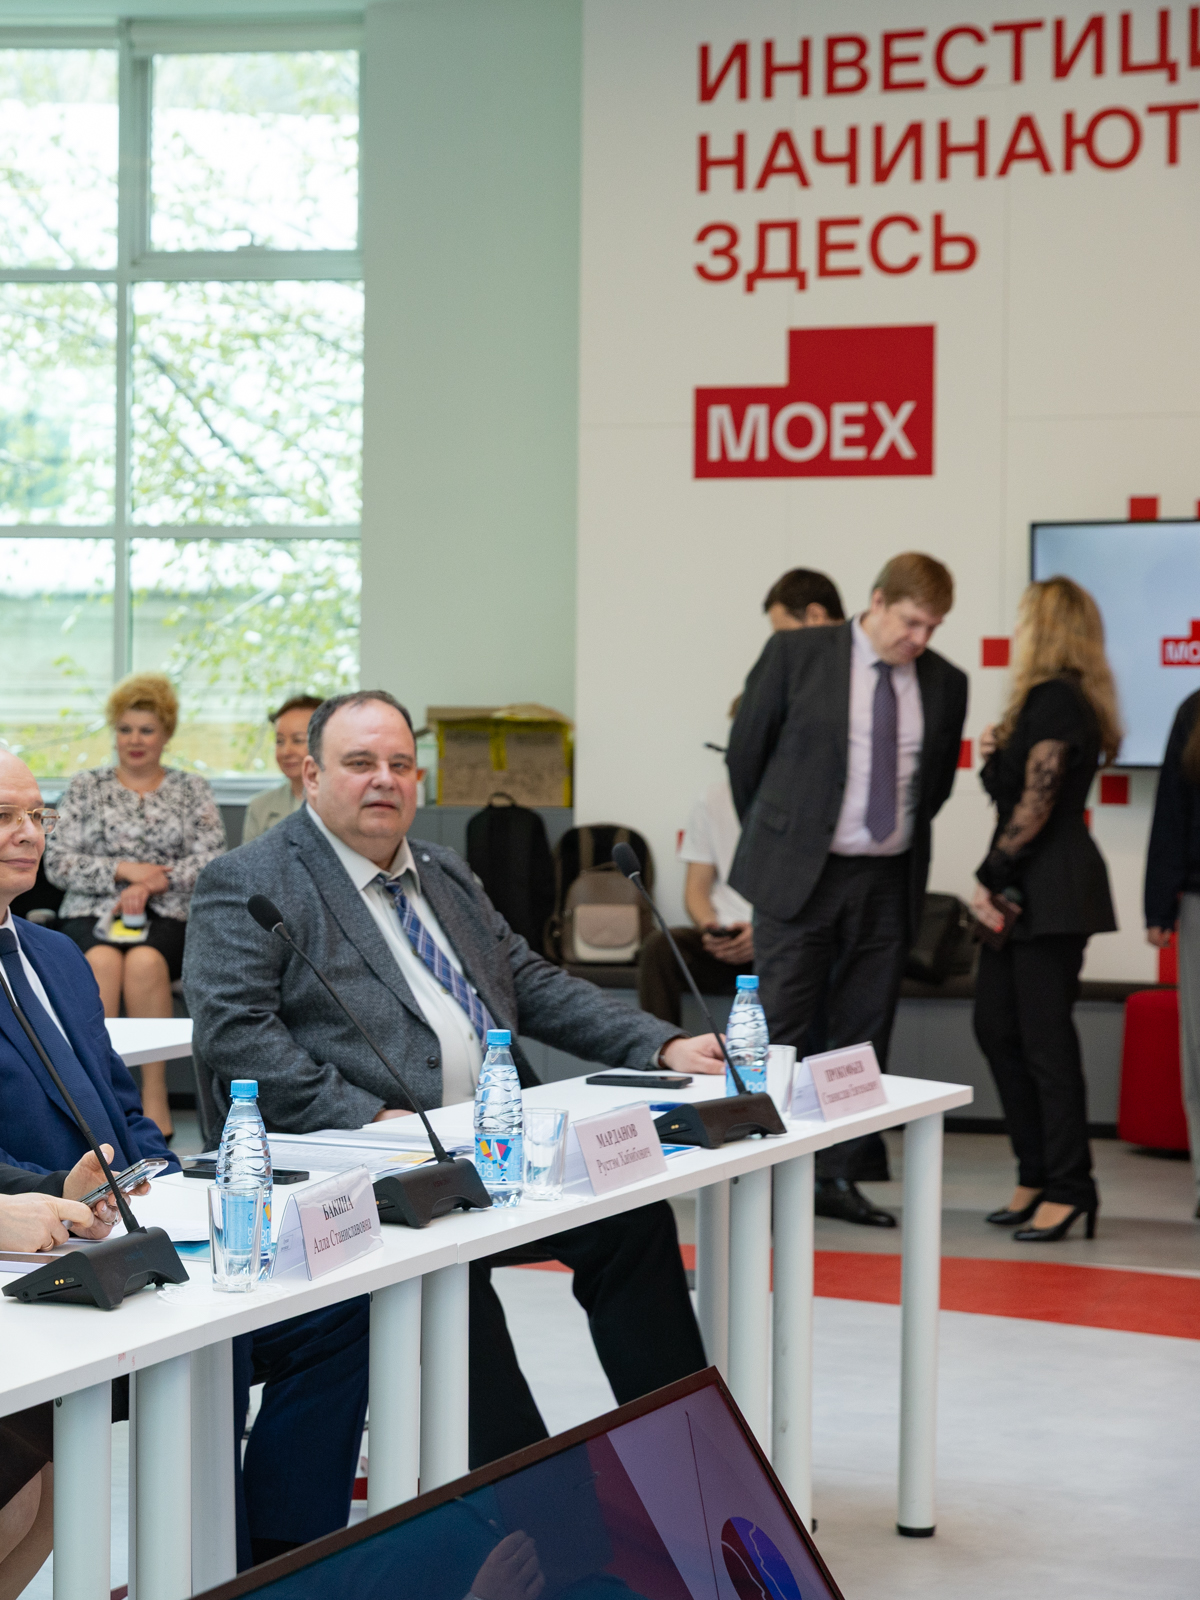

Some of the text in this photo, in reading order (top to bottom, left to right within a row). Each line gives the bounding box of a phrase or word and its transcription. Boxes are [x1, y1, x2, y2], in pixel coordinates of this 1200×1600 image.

[698, 5, 1200, 104] ИНВЕСТИЦ
[697, 101, 1200, 193] НАЧИНАЮТ
[694, 211, 980, 294] ЗДЕСЬ
[706, 400, 918, 463] MOEX
[596, 1123, 638, 1148] МАРДАНОВ
[322, 1194, 354, 1221] БАКИНА
[314, 1236, 331, 1255] Алла
